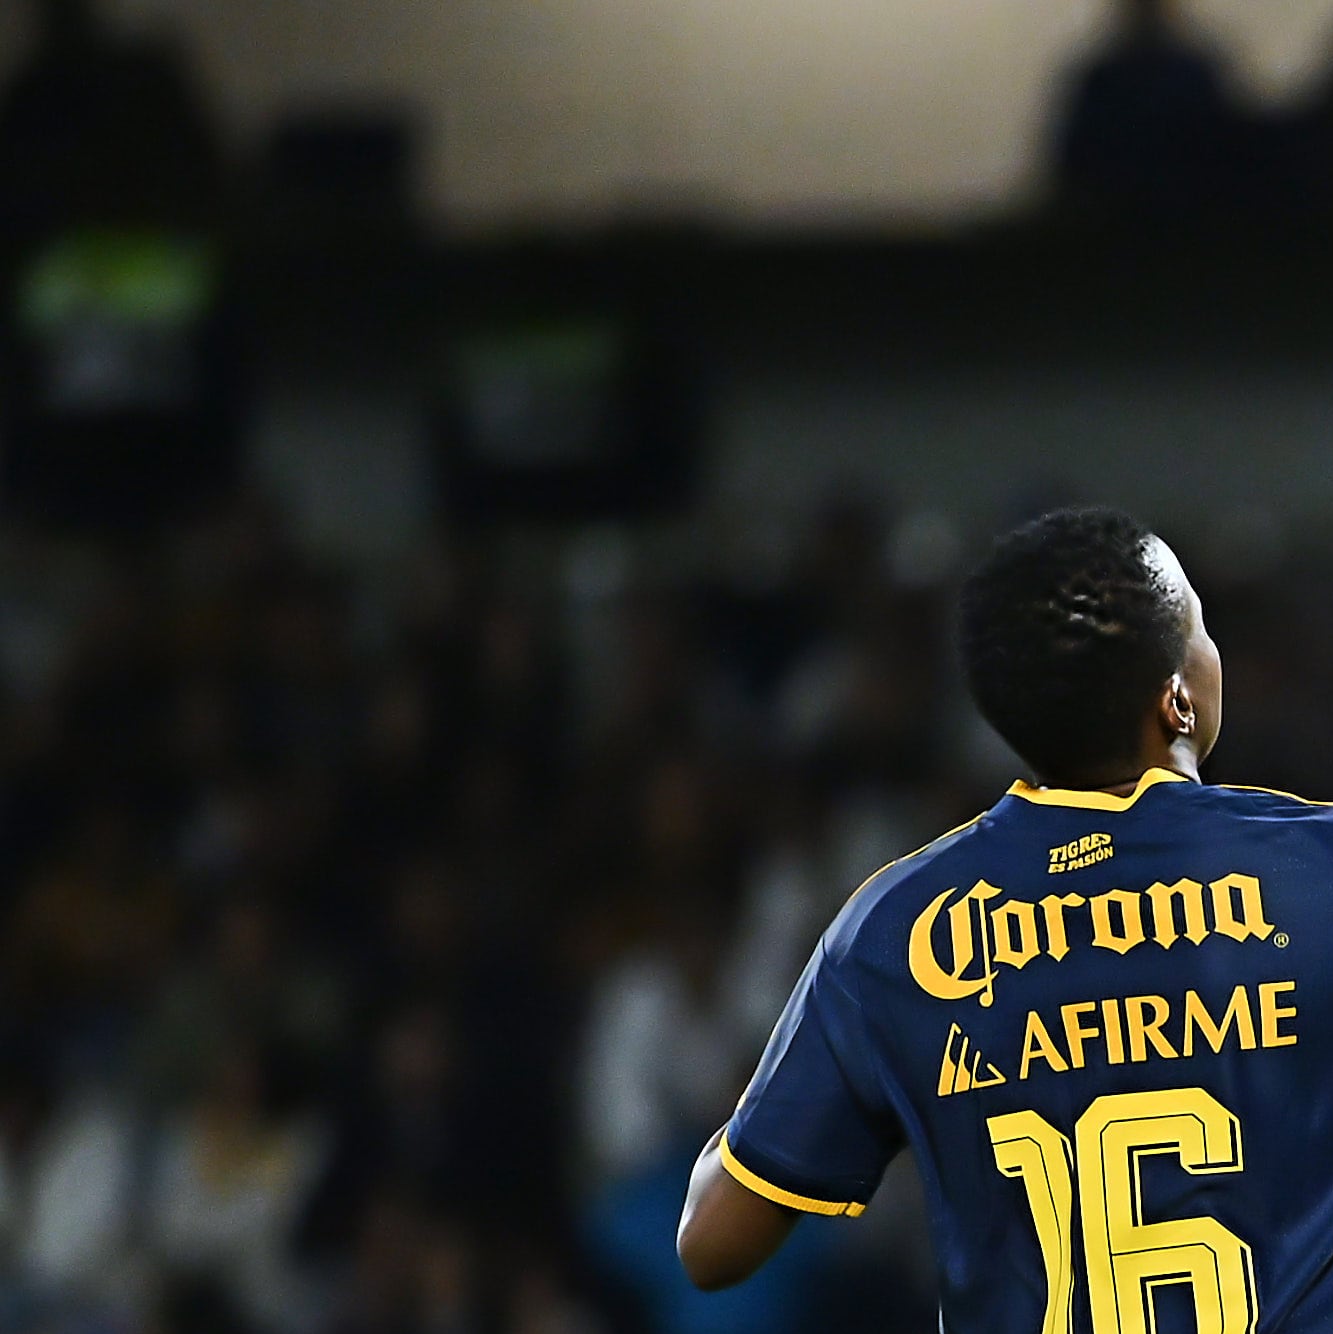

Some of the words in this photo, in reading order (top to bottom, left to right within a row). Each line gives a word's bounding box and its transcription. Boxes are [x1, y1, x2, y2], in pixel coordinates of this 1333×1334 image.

[1047, 863, 1066, 874] ES
[1049, 833, 1112, 863] TIGRES
[908, 872, 1276, 1007] Corona
[1018, 981, 1298, 1080] AFIRME
